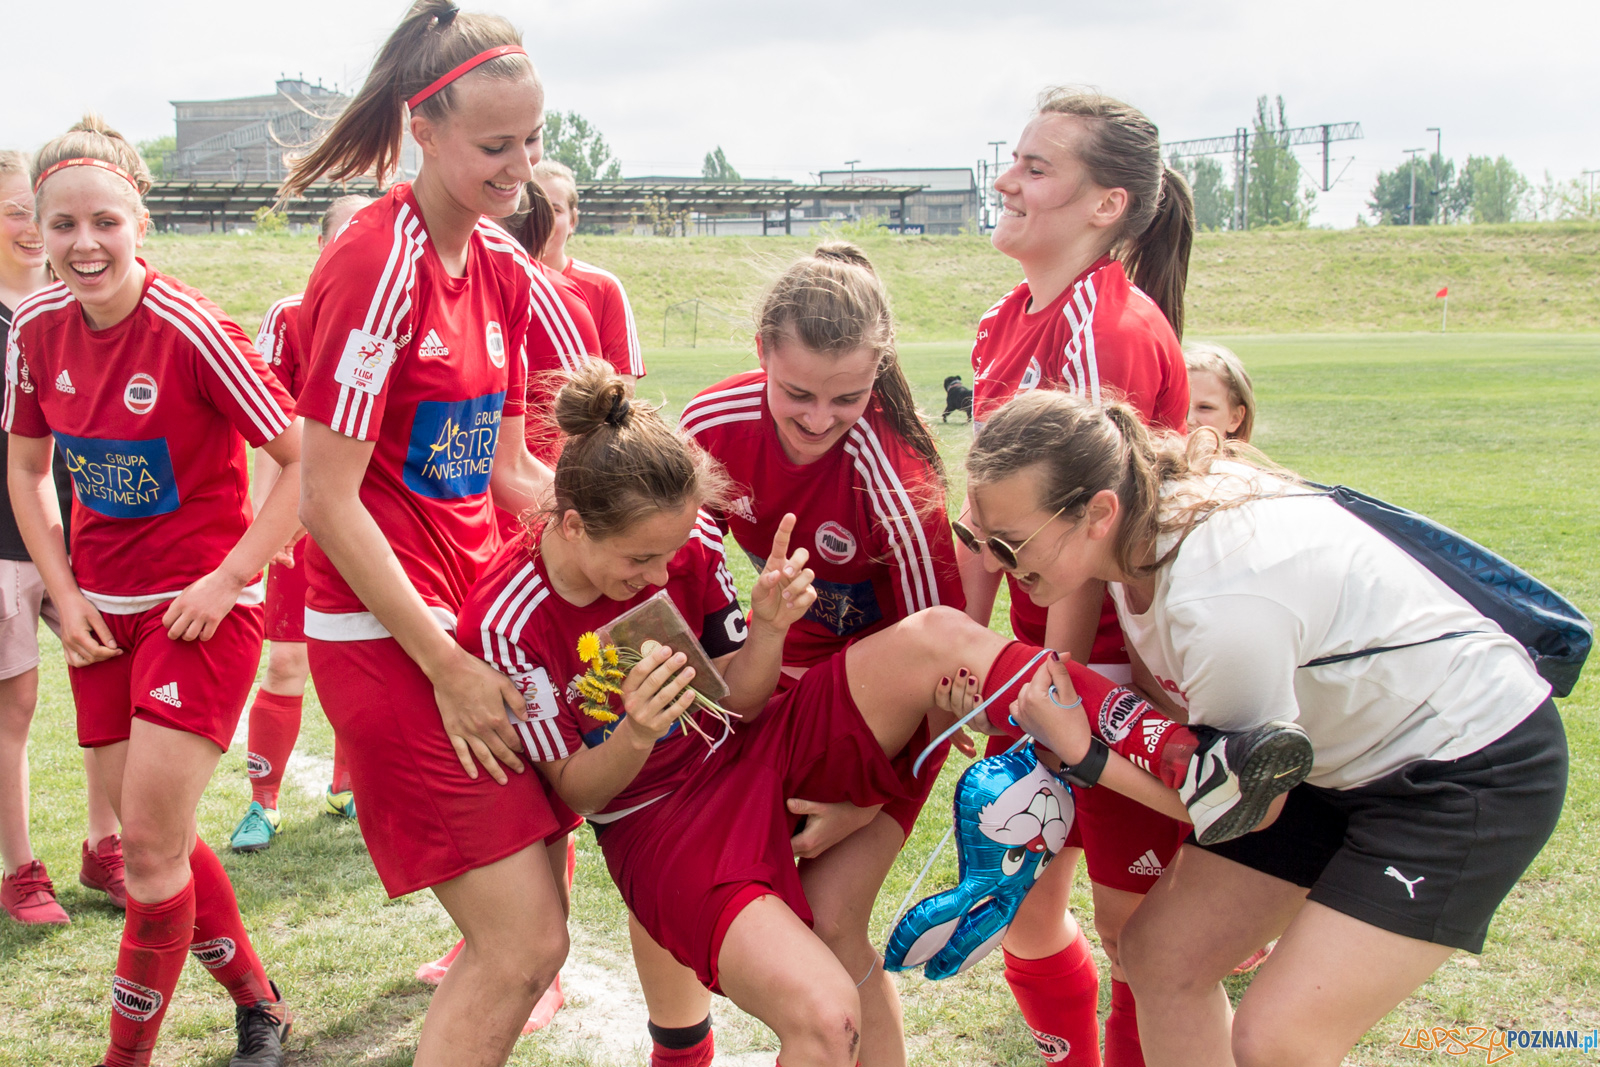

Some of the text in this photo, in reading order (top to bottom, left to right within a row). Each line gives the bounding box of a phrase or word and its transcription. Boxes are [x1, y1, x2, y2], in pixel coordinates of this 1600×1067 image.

[418, 347, 449, 357] adidas
[358, 369, 373, 381] LIGA
[129, 386, 152, 400] POLONIA
[105, 453, 149, 467] GRUPA
[66, 448, 160, 491] ASTRA
[822, 534, 848, 553] POLONIA
[815, 587, 855, 604] RUPA
[723, 609, 748, 642] C
[149, 690, 182, 708] adidas
